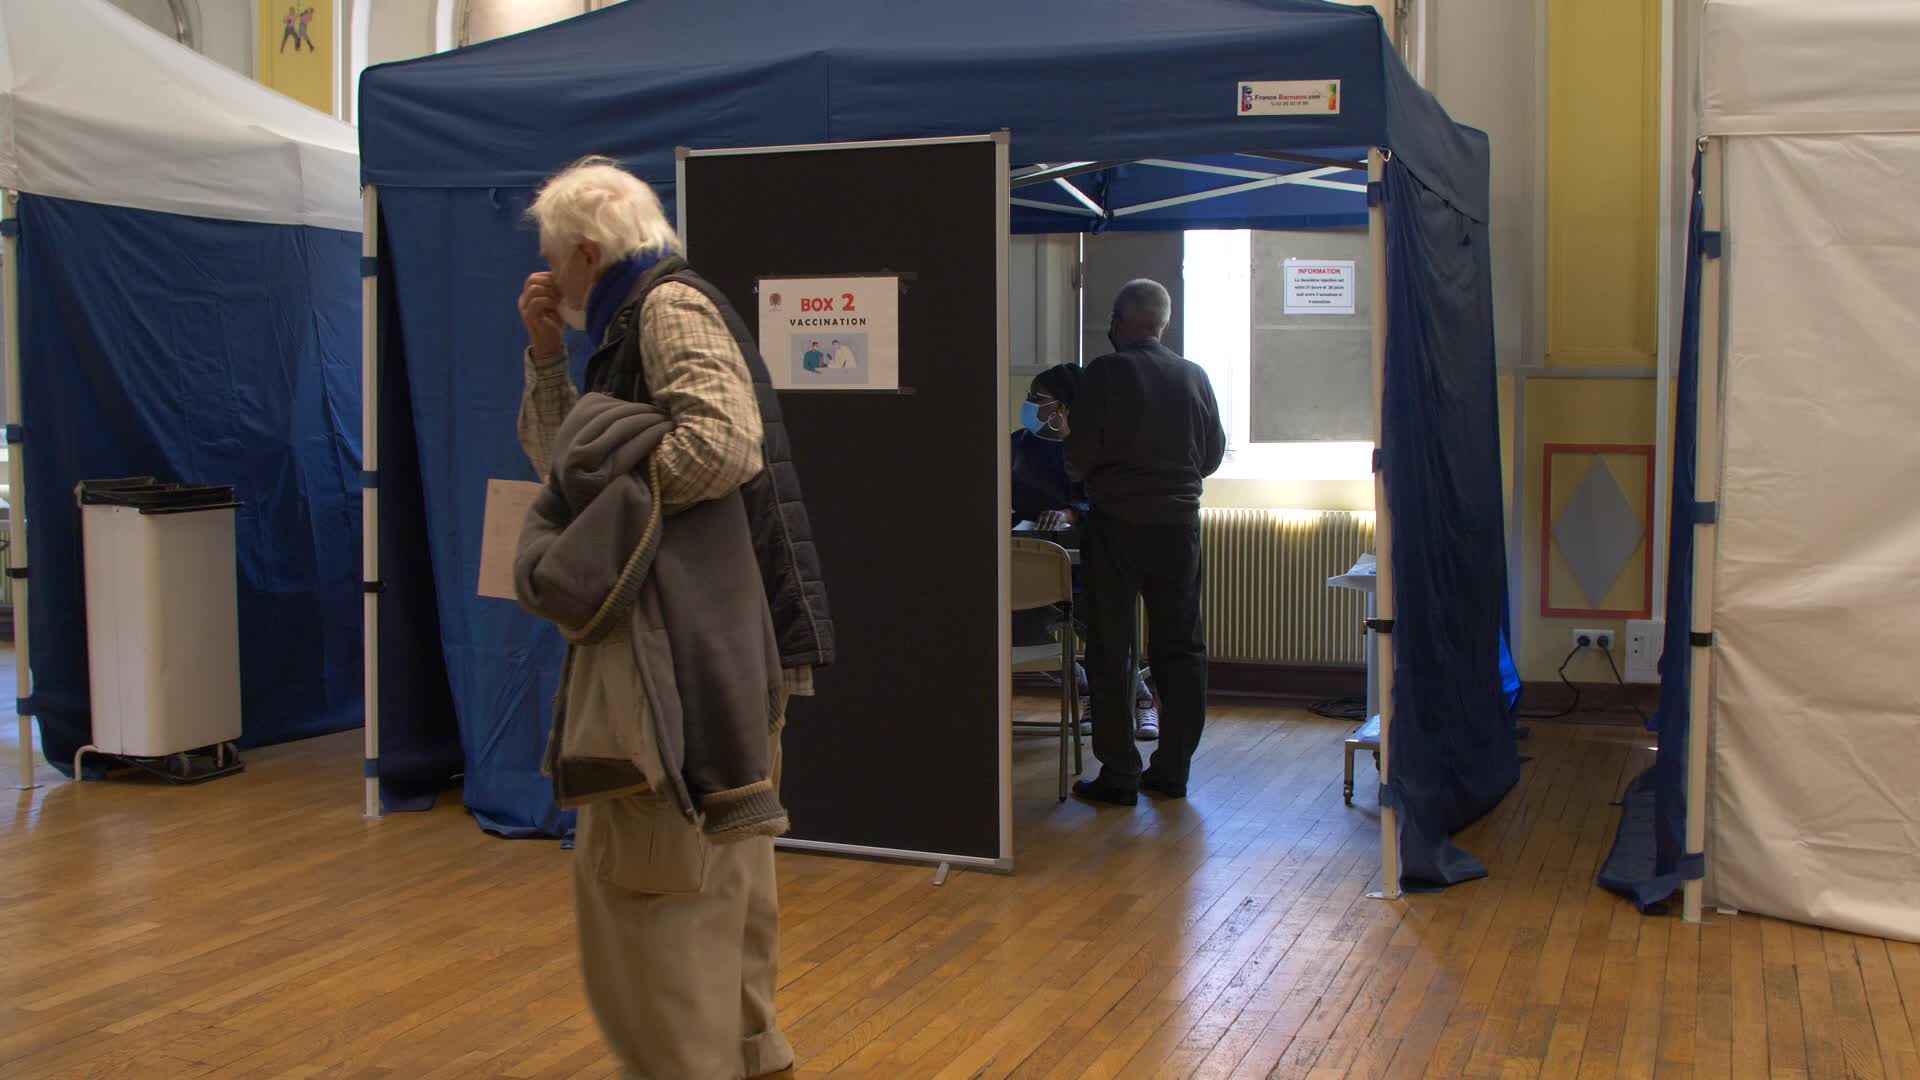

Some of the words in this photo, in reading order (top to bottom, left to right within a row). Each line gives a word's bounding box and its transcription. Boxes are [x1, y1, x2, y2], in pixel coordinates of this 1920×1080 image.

[801, 298, 833, 312] BOX
[842, 293, 855, 311] 2
[790, 318, 866, 327] VACCINATION
